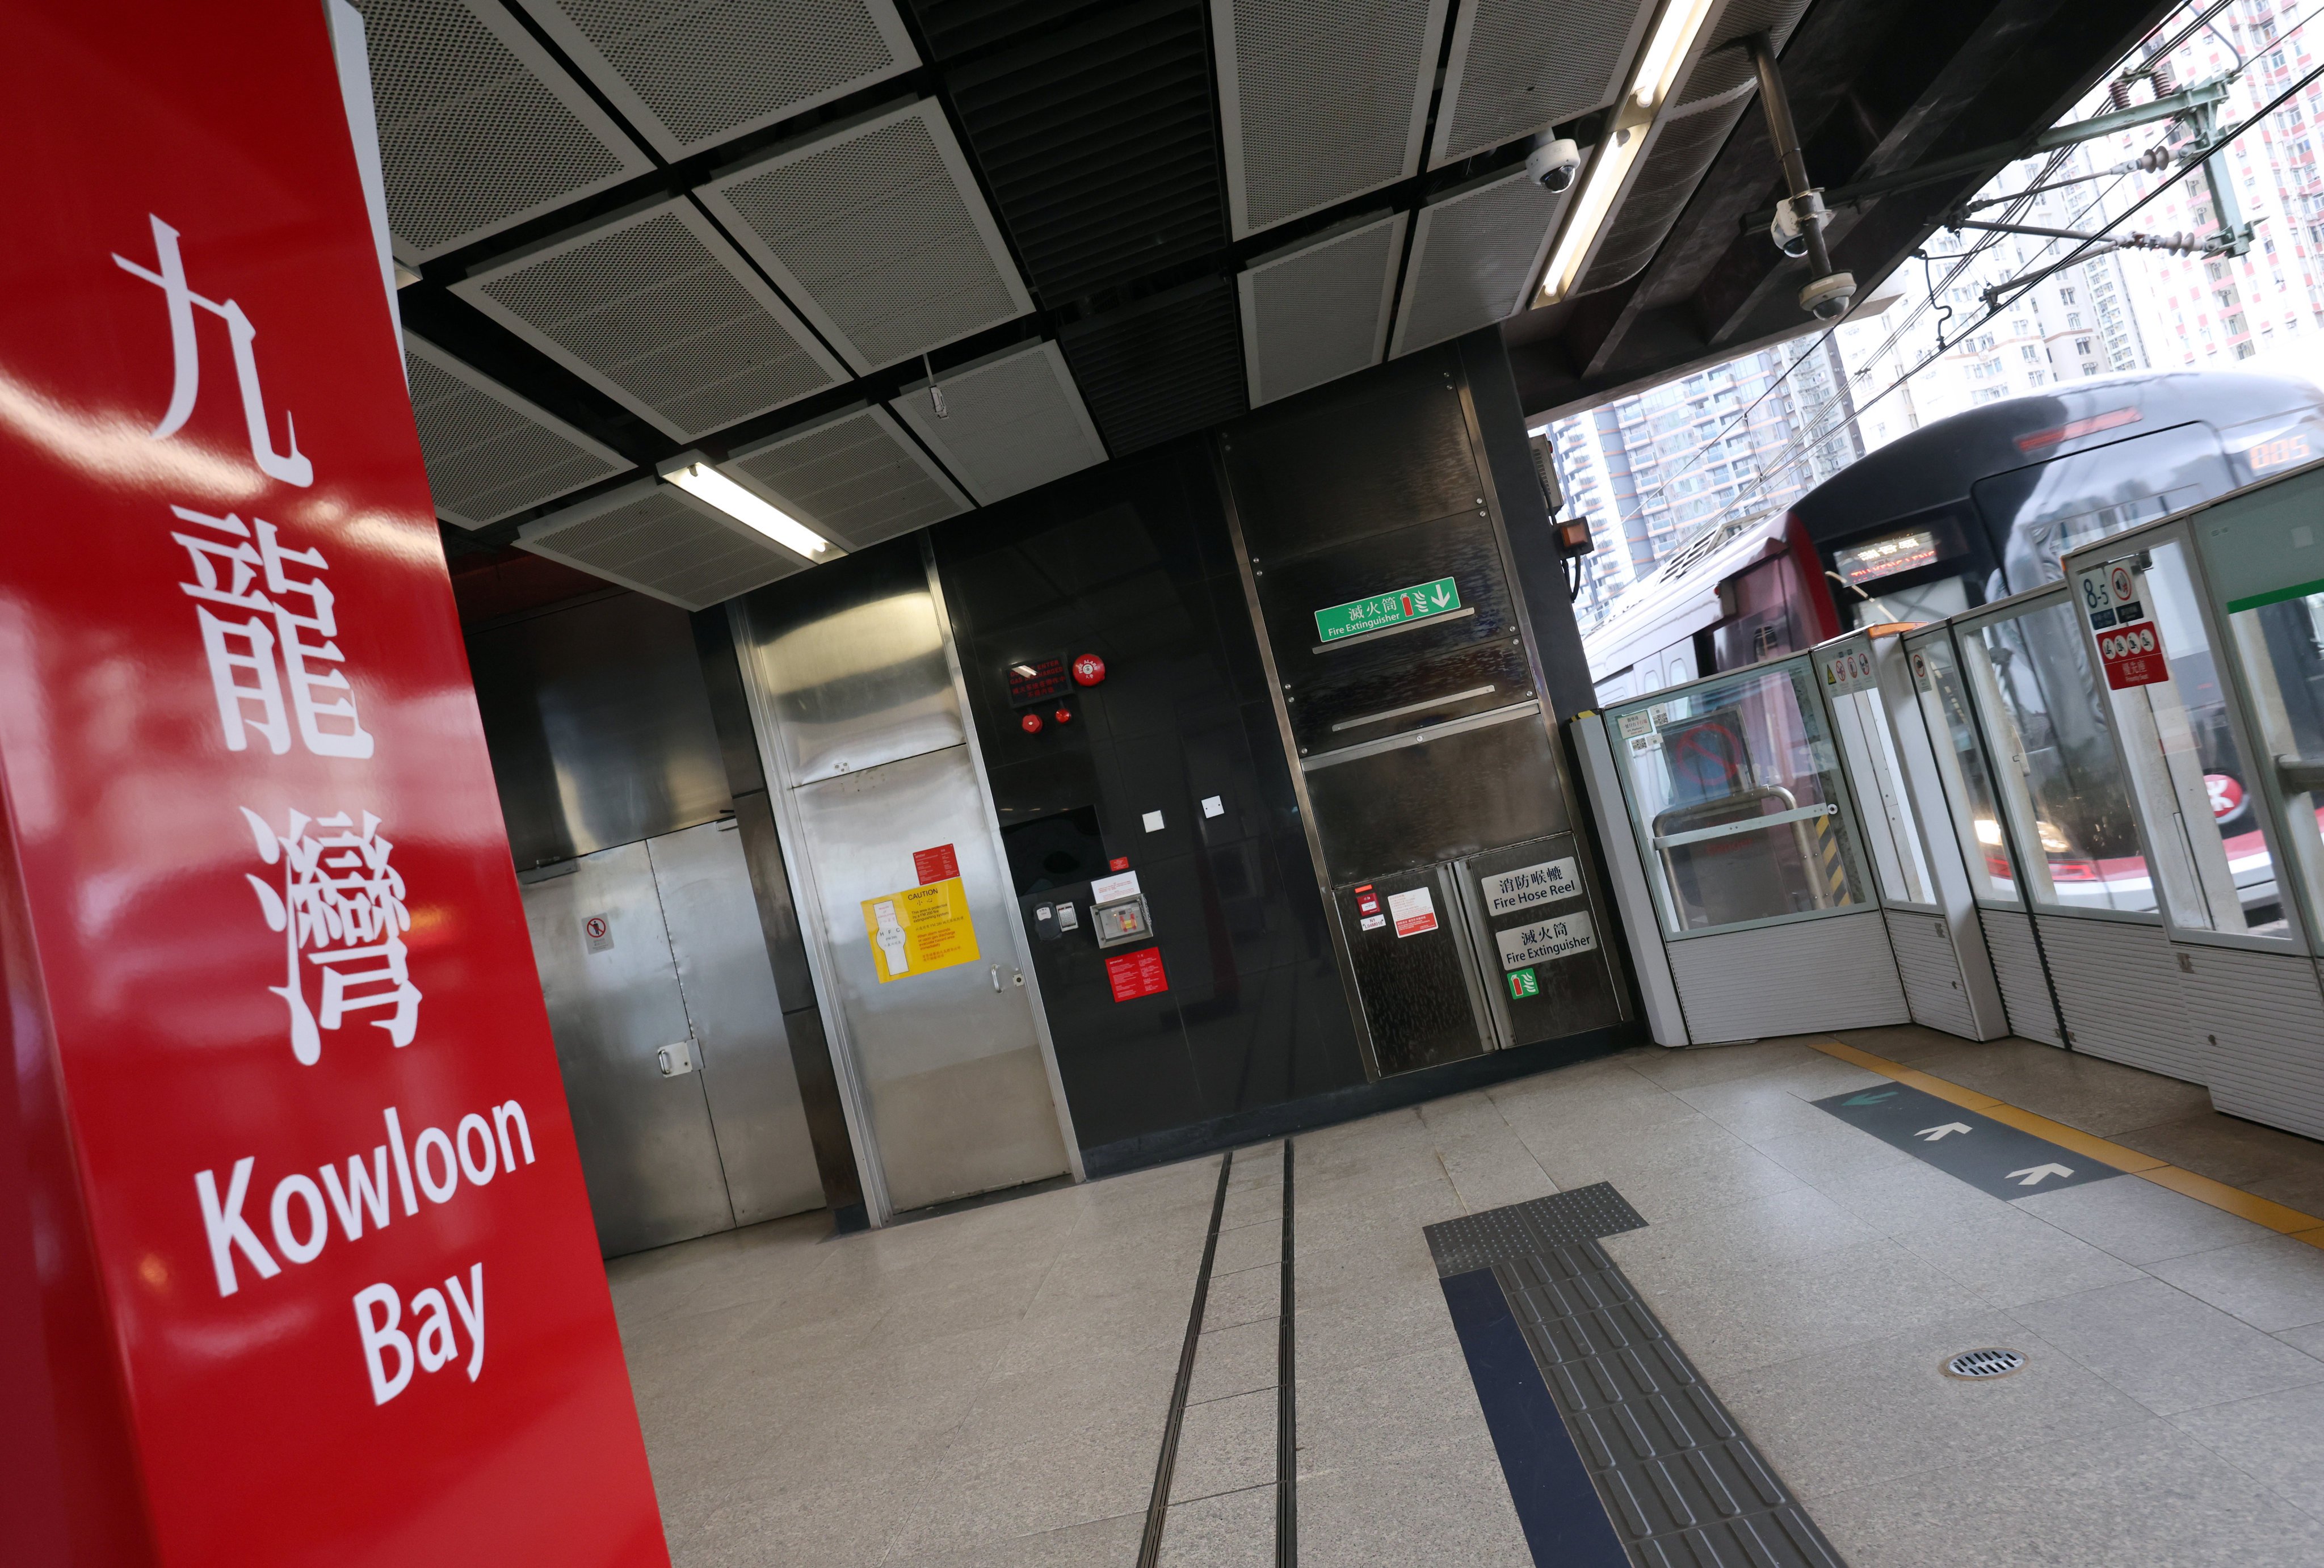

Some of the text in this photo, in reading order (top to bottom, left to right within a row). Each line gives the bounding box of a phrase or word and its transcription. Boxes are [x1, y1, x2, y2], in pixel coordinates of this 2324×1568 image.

[2083, 578, 2109, 608] 8-5
[1348, 596, 1397, 621] 滅火筒
[1328, 612, 1400, 637] Fire Extinguisher
[111, 213, 421, 1067] 九龍灣
[1037, 660, 1059, 670] ENTER
[1083, 659, 1097, 670] ALARM
[1499, 865, 1564, 894] 消防喉轆
[907, 888, 938, 901] CAUTION
[1493, 880, 1575, 910] Fire Hose Reel
[1521, 920, 1569, 946] 滅火筒
[1506, 935, 1591, 965] Fire Extinguisher
[194, 1099, 536, 1298] Kowloon
[352, 1262, 485, 1407] Bay
